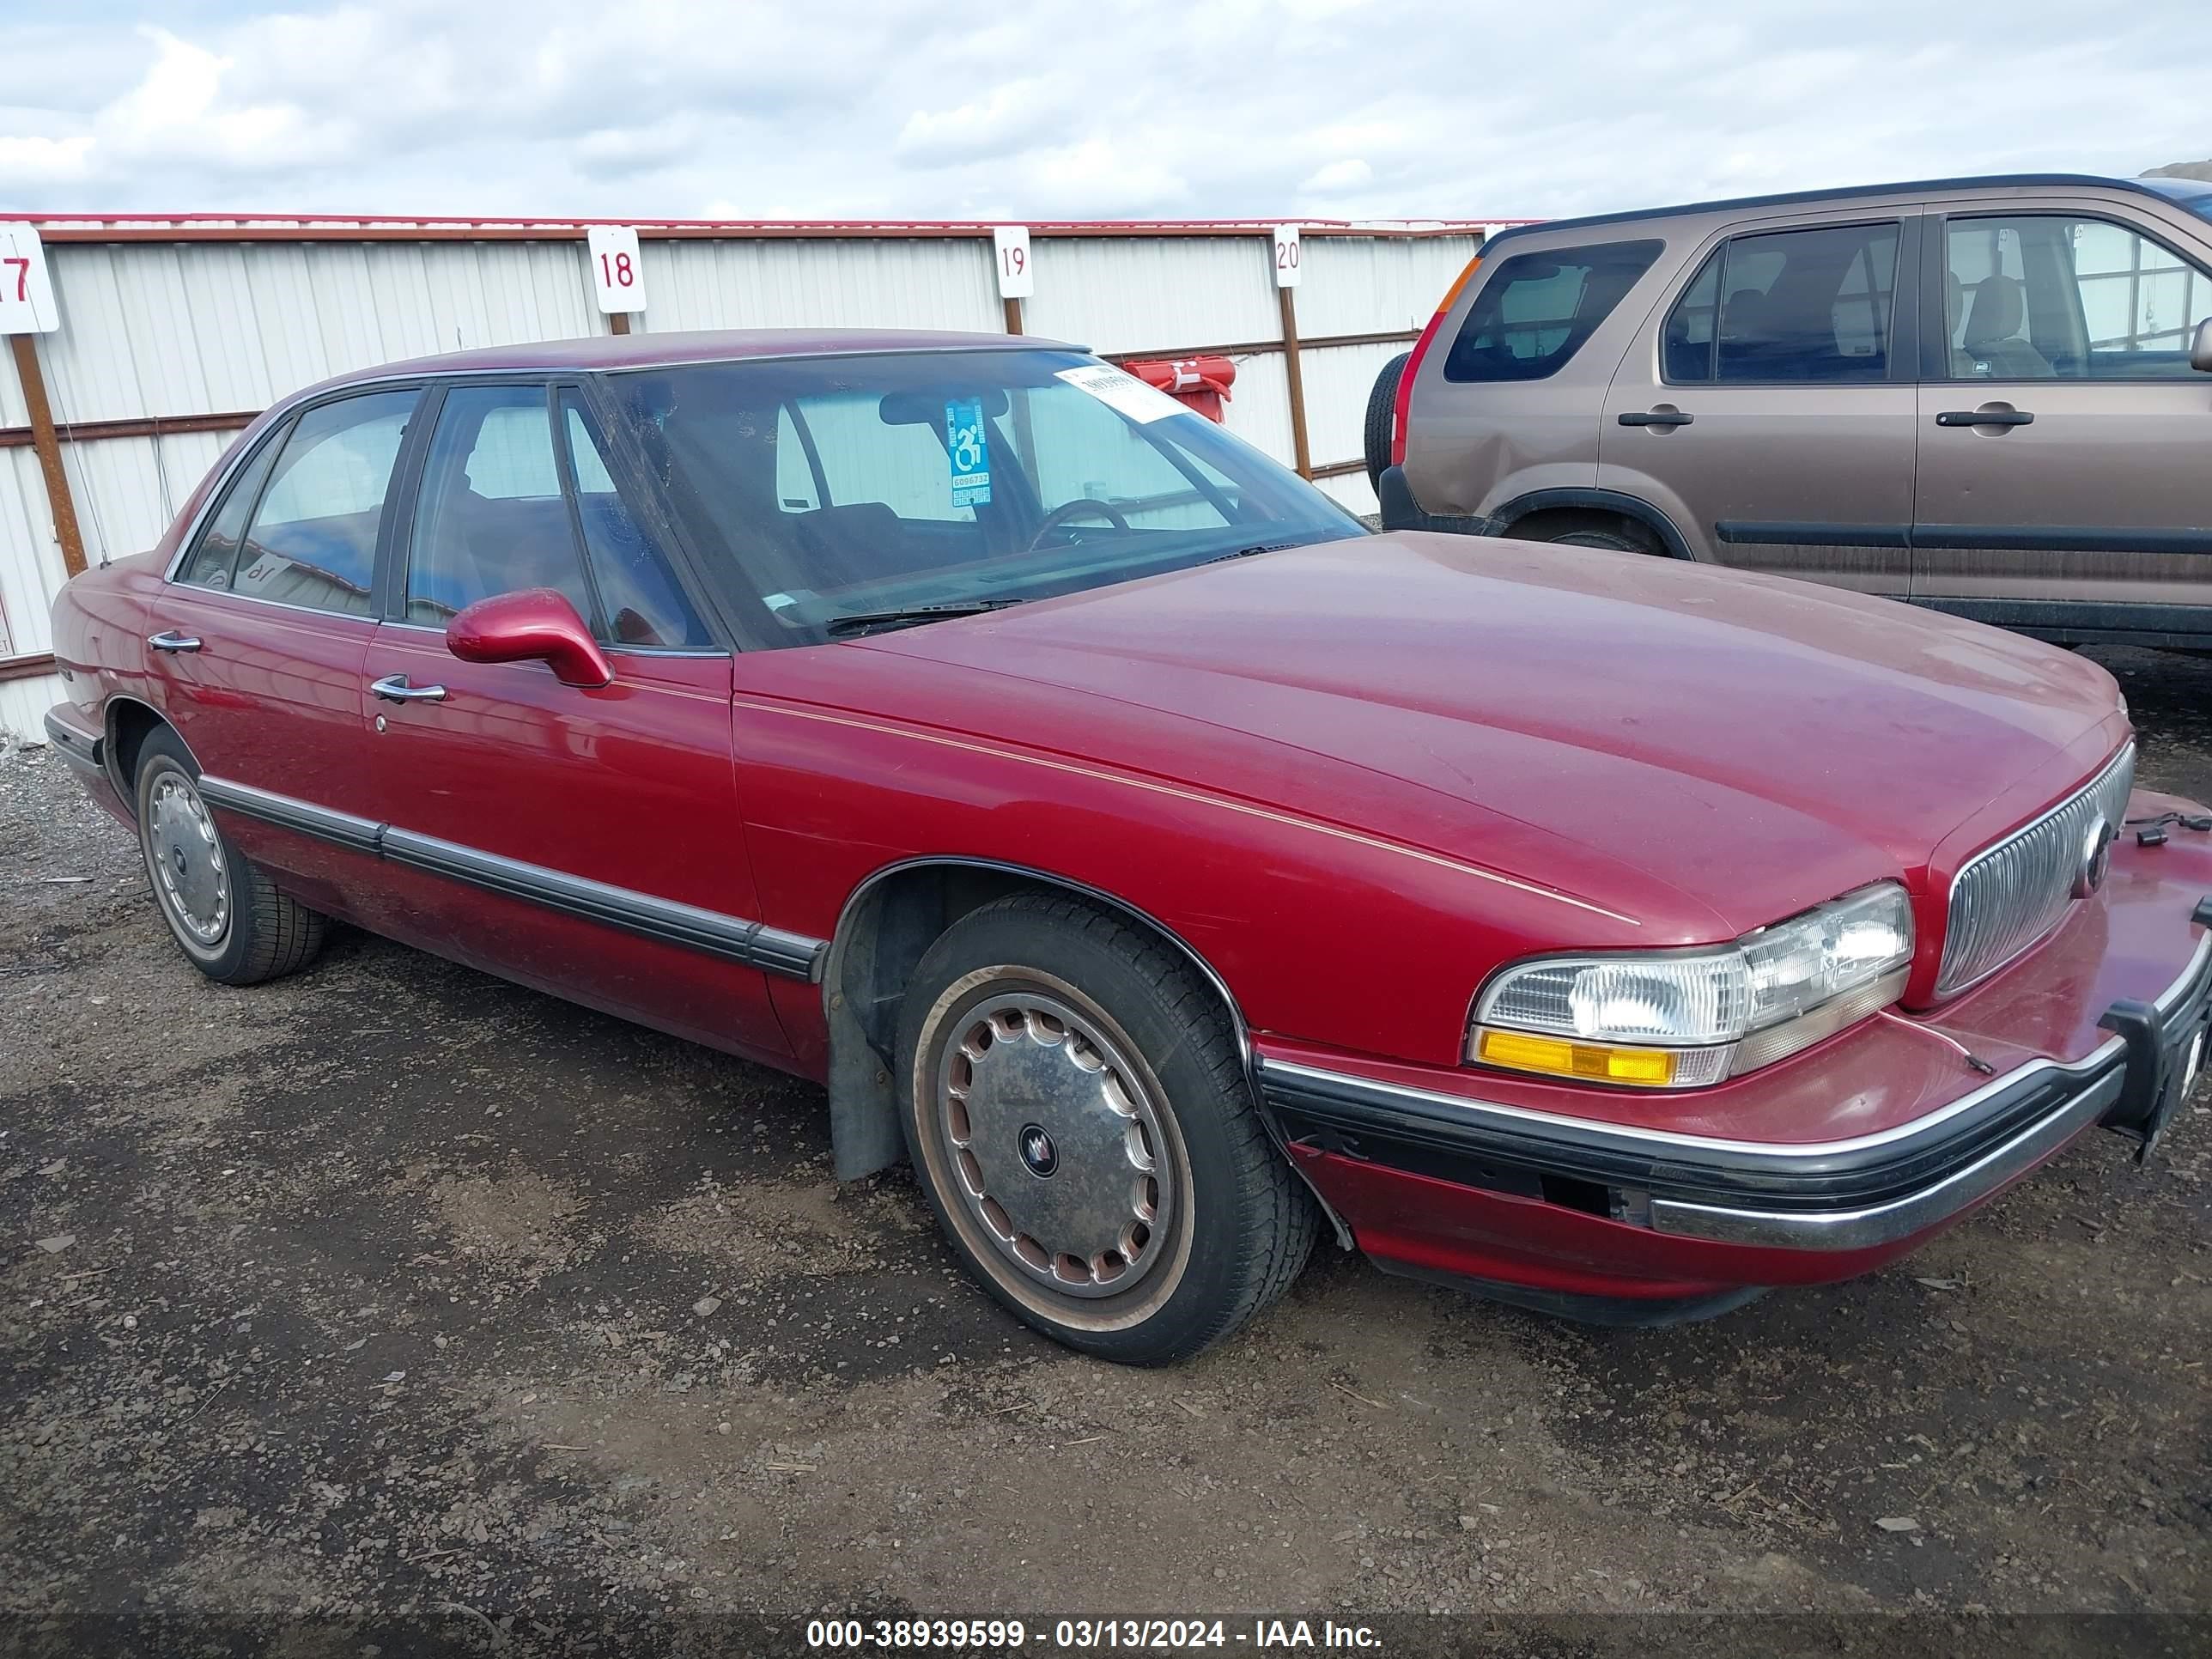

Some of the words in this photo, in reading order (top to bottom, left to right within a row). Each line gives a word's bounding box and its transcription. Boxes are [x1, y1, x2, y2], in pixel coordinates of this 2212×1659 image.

[601, 252, 633, 288] 18
[1003, 247, 1024, 276] 19
[1278, 241, 1298, 269] 20
[0, 258, 29, 302] 7
